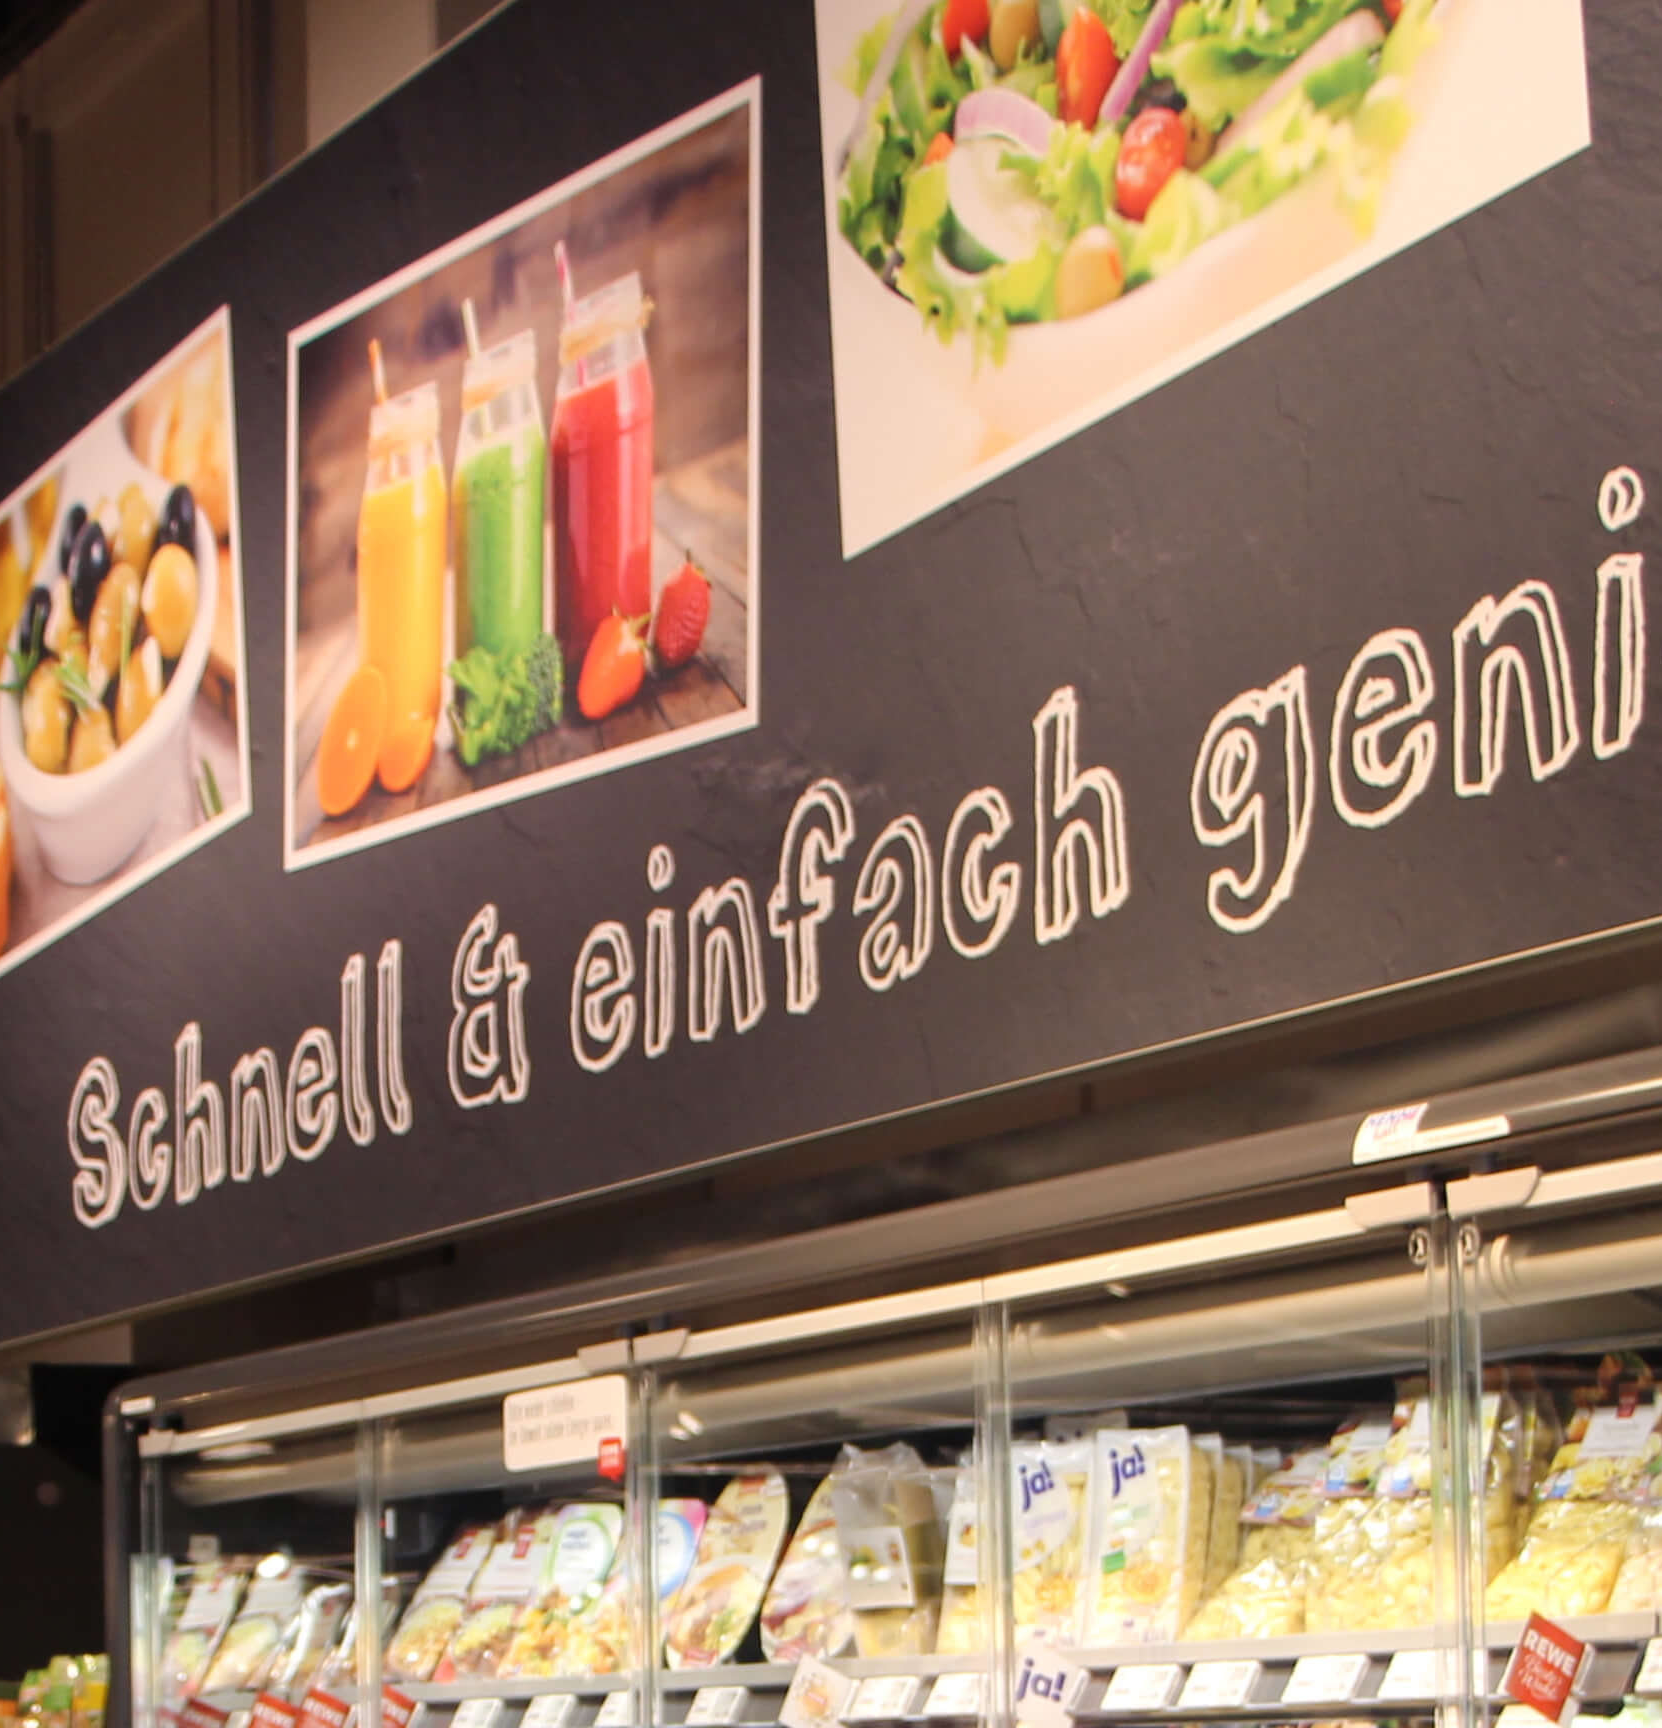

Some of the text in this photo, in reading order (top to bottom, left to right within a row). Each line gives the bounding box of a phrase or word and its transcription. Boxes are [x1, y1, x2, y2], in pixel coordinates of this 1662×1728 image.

[70, 940, 411, 1228] Schnell
[448, 904, 529, 1108] &
[572, 689, 1131, 1073] einfach
[1018, 1458, 1055, 1512] ja!
[1110, 1443, 1145, 1498] ja!
[1523, 1627, 1576, 1678] REWE
[1016, 1657, 1067, 1703] ja!
